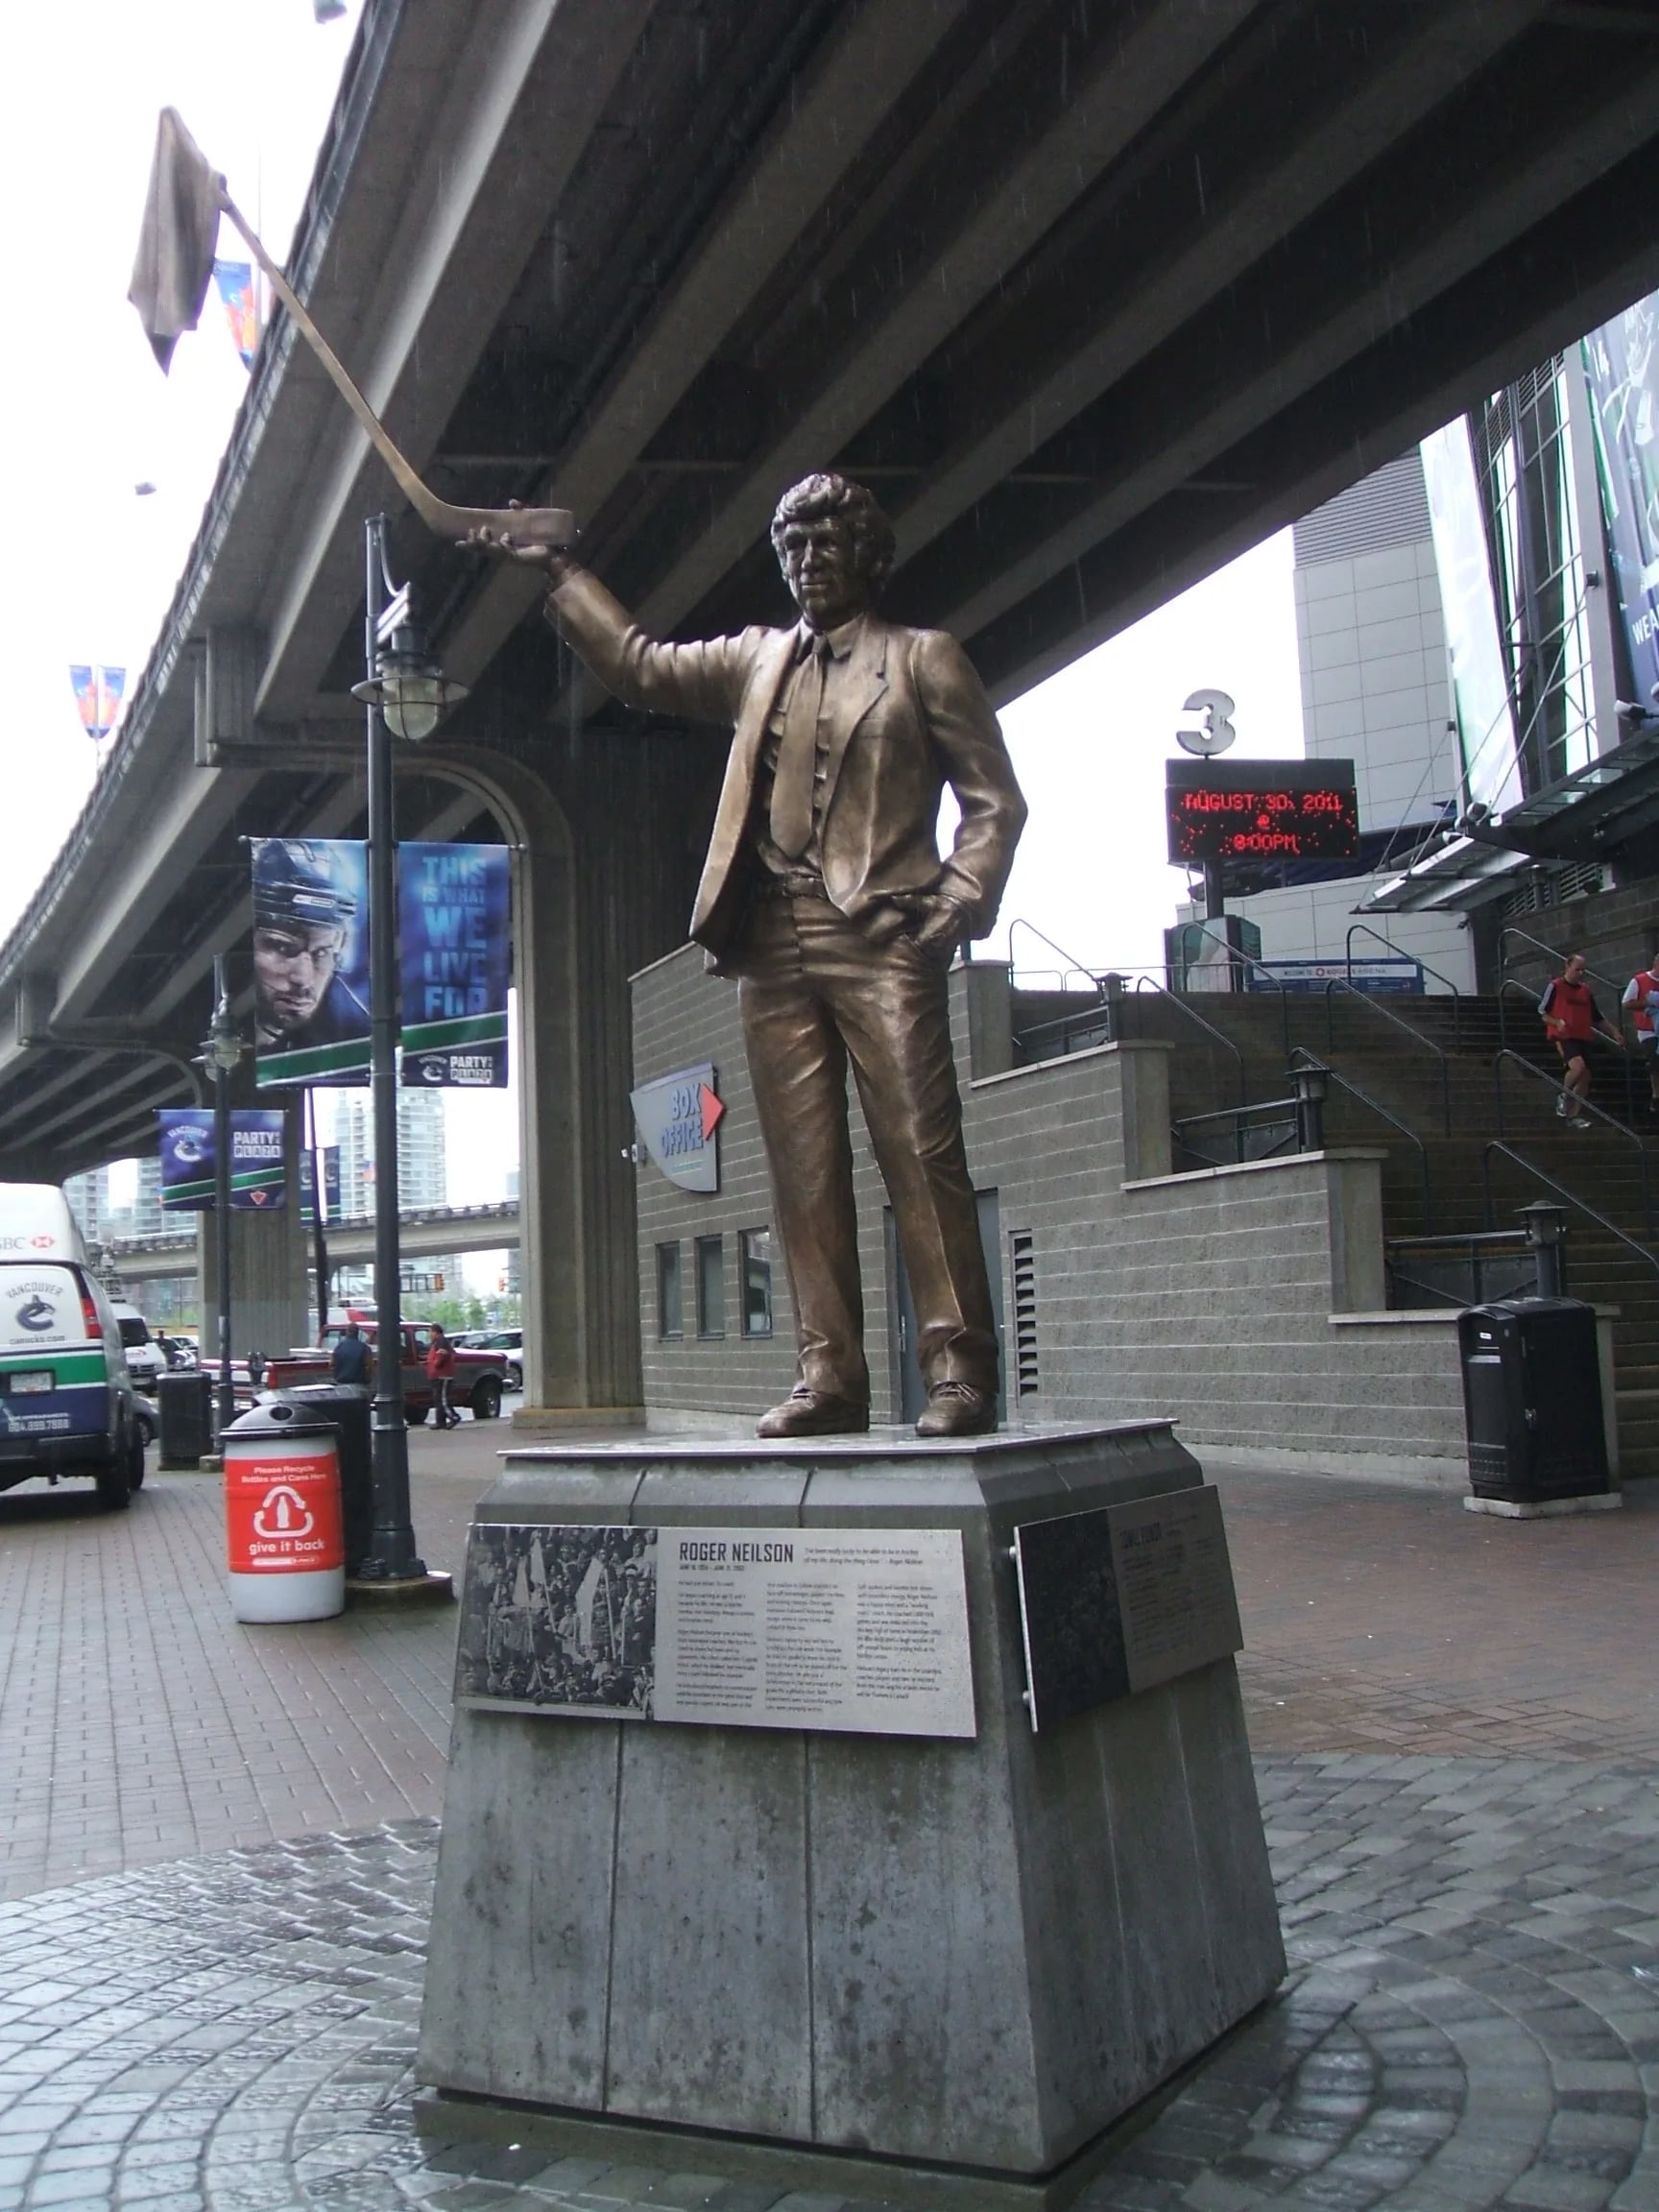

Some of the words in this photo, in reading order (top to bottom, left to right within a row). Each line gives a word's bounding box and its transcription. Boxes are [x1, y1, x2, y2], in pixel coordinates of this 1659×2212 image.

[1176, 688, 1237, 757] 3
[1184, 791, 1255, 812] AUGUST
[1303, 792, 1343, 811] 2011
[422, 855, 487, 885] THIS
[422, 887, 439, 902] IS
[443, 887, 485, 903] WHAT
[424, 905, 488, 949] WE
[423, 951, 487, 984] LIVE
[424, 985, 488, 1021] FOR
[449, 1055, 487, 1069] PARTY
[670, 1082, 702, 1121] BOX
[233, 1131, 274, 1145] PARTY
[661, 1117, 705, 1159] OFFICE
[233, 1144, 281, 1158] PLAZA
[0, 1237, 26, 1250] BC
[6, 1282, 64, 1299] VANCOUVER
[270, 1475, 287, 1483] and
[288, 1474, 308, 1482] Cans
[283, 1465, 315, 1474] Recycle
[249, 1541, 276, 1555] give
[280, 1541, 291, 1552] it
[295, 1538, 325, 1552] back
[679, 1542, 727, 1562] ROGER
[732, 1543, 794, 1564] NEILSON
